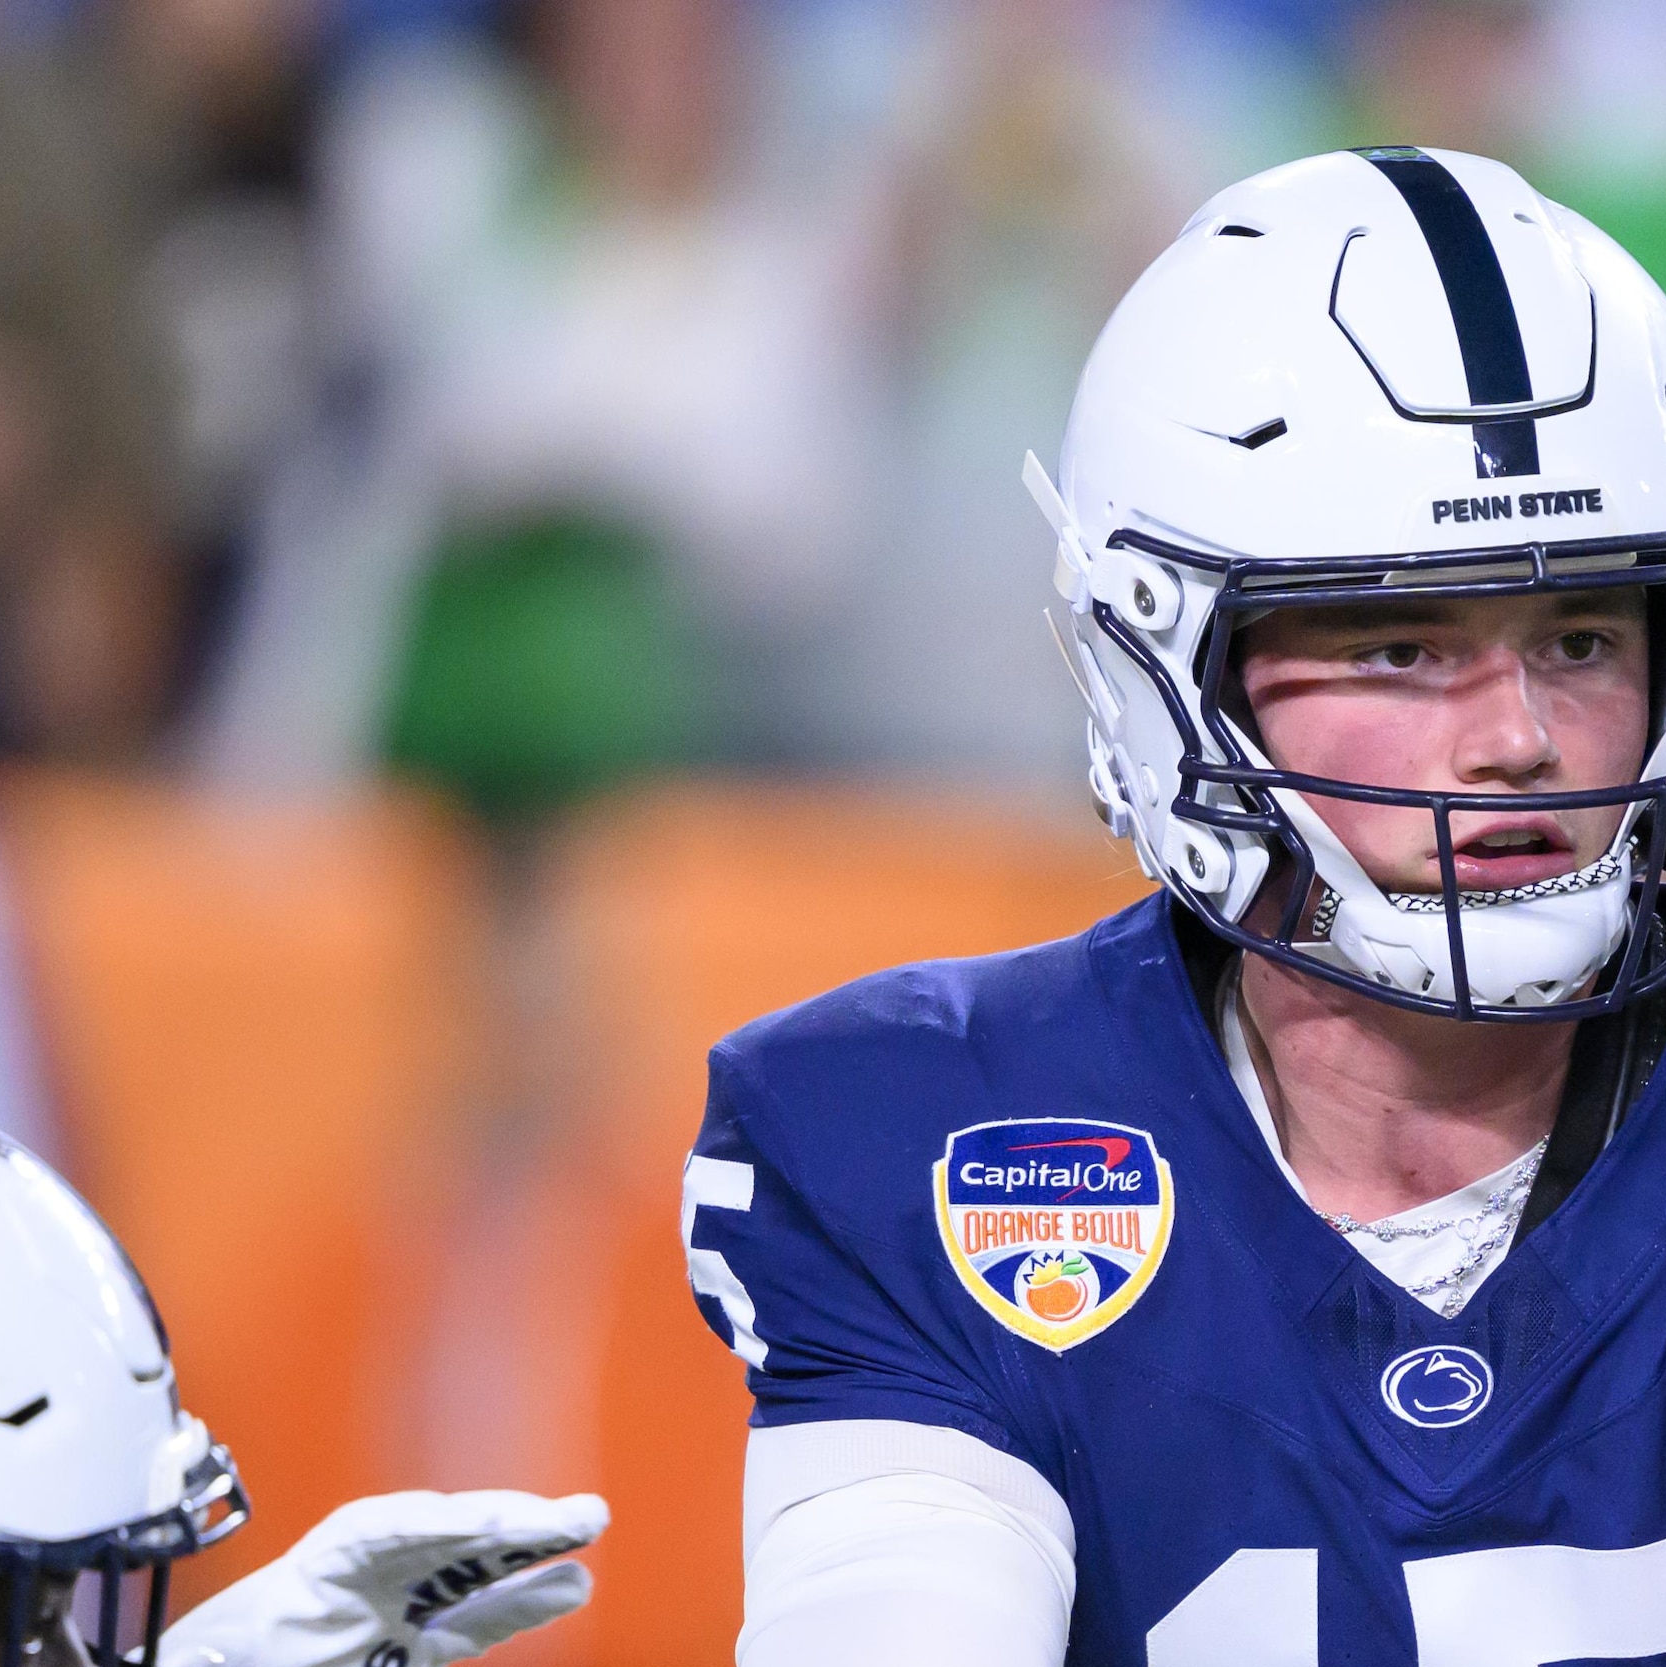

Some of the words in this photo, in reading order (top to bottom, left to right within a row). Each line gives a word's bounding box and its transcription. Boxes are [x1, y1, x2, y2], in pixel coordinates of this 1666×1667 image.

[1433, 495, 1512, 524] PENN
[1519, 488, 1603, 517] STATE
[964, 1211, 1064, 1255] ORANGE
[1072, 1209, 1147, 1255] BOWL
[681, 1148, 769, 1372] 5
